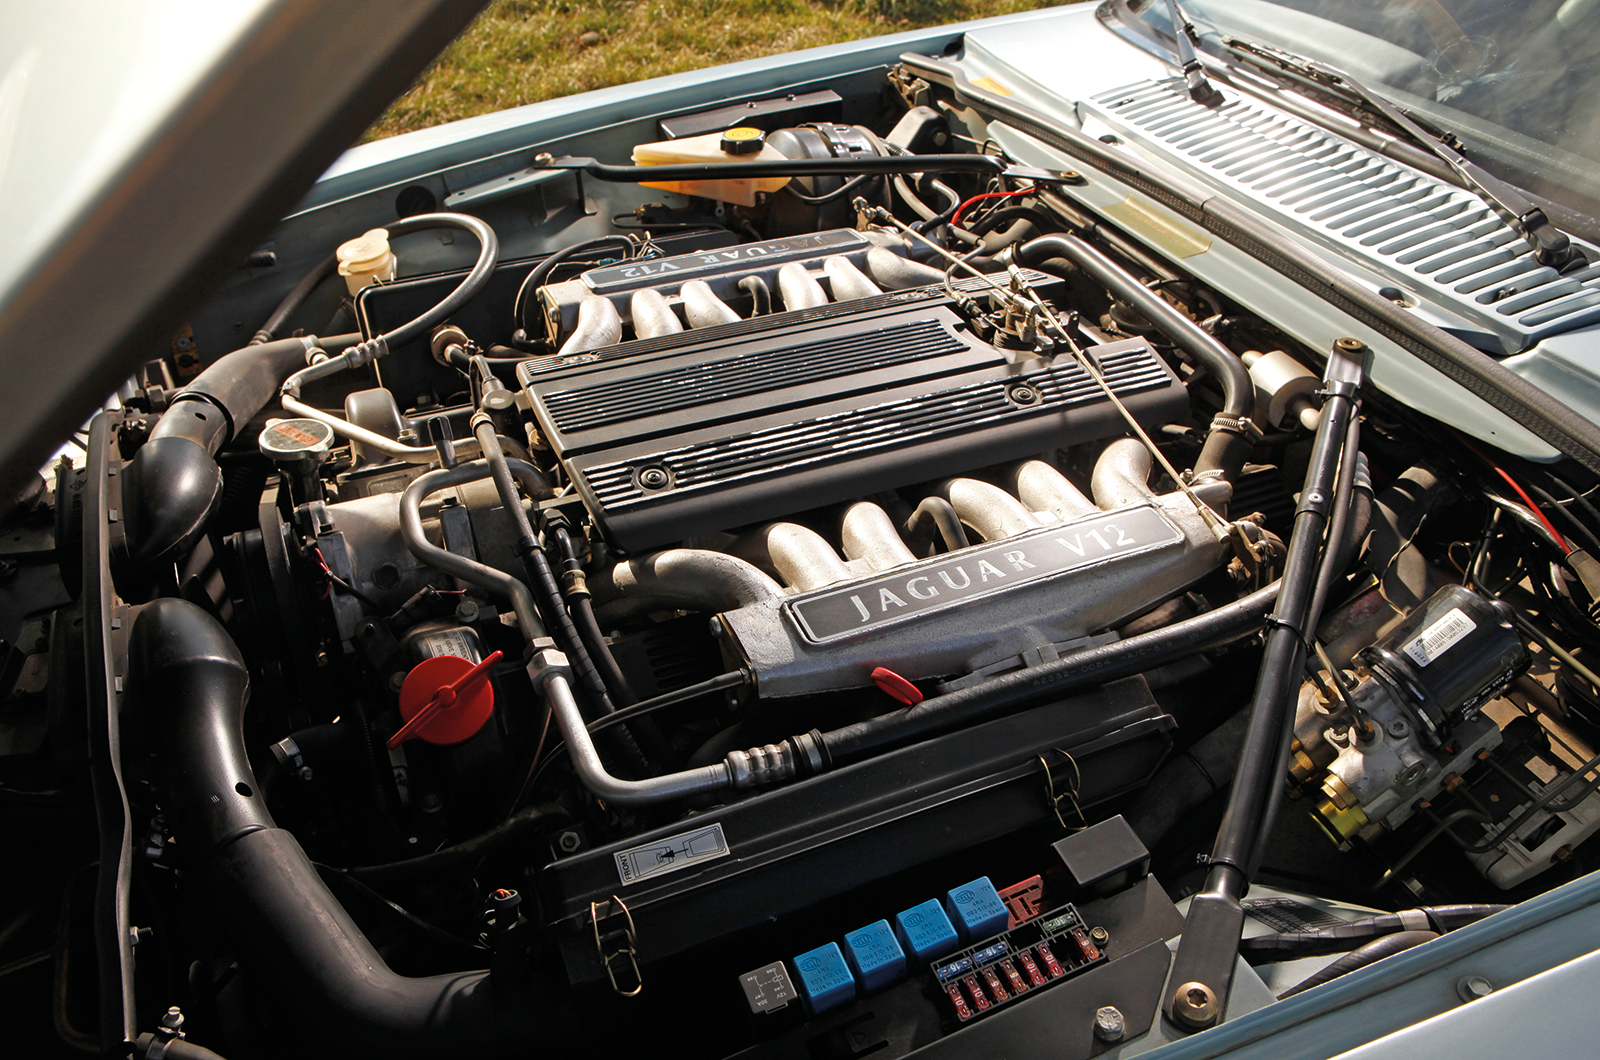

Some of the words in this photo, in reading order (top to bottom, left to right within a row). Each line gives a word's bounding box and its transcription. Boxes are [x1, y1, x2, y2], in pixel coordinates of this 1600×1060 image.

[701, 236, 828, 264] JAGUAR
[620, 261, 680, 278] V12
[850, 550, 1036, 622] JAGUAR
[1054, 524, 1136, 557] V12
[620, 854, 632, 880] FRONT
[986, 947, 997, 957] 15
[1045, 954, 1055, 964] 10
[950, 962, 961, 972] 15
[1026, 963, 1037, 973] 10
[973, 988, 983, 998] 10
[954, 996, 964, 1006] 10
